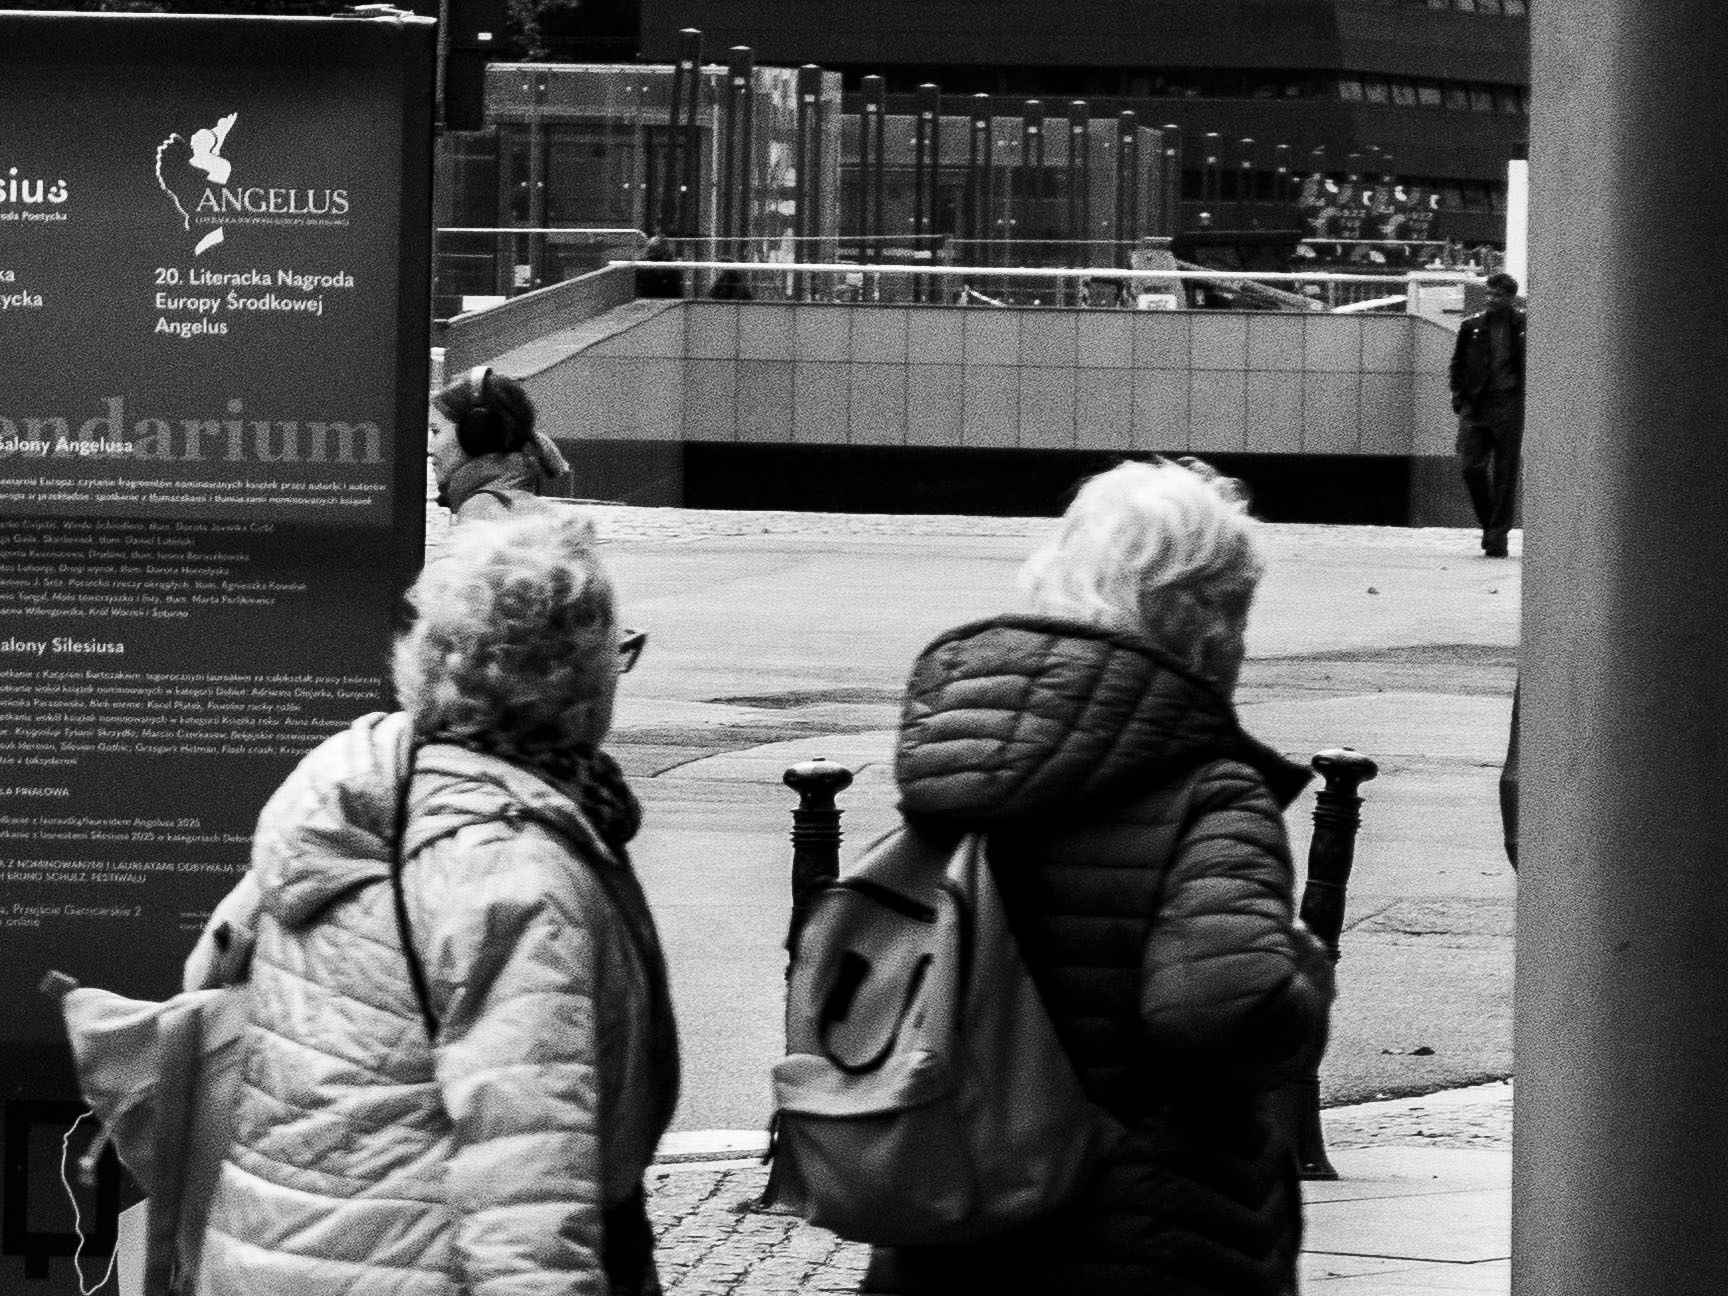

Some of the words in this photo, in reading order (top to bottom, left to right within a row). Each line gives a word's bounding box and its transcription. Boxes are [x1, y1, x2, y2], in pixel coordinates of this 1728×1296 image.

[195, 186, 349, 215] ANGELUS
[154, 267, 184, 286] 20.
[189, 268, 272, 286] Literacka
[277, 269, 355, 292] Nagroda
[155, 292, 221, 314] Europy
[226, 289, 324, 316] Środkowej
[154, 316, 229, 339] Angelus
[55, 435, 134, 457] Angelusa
[51, 636, 125, 655] Silesiusa
